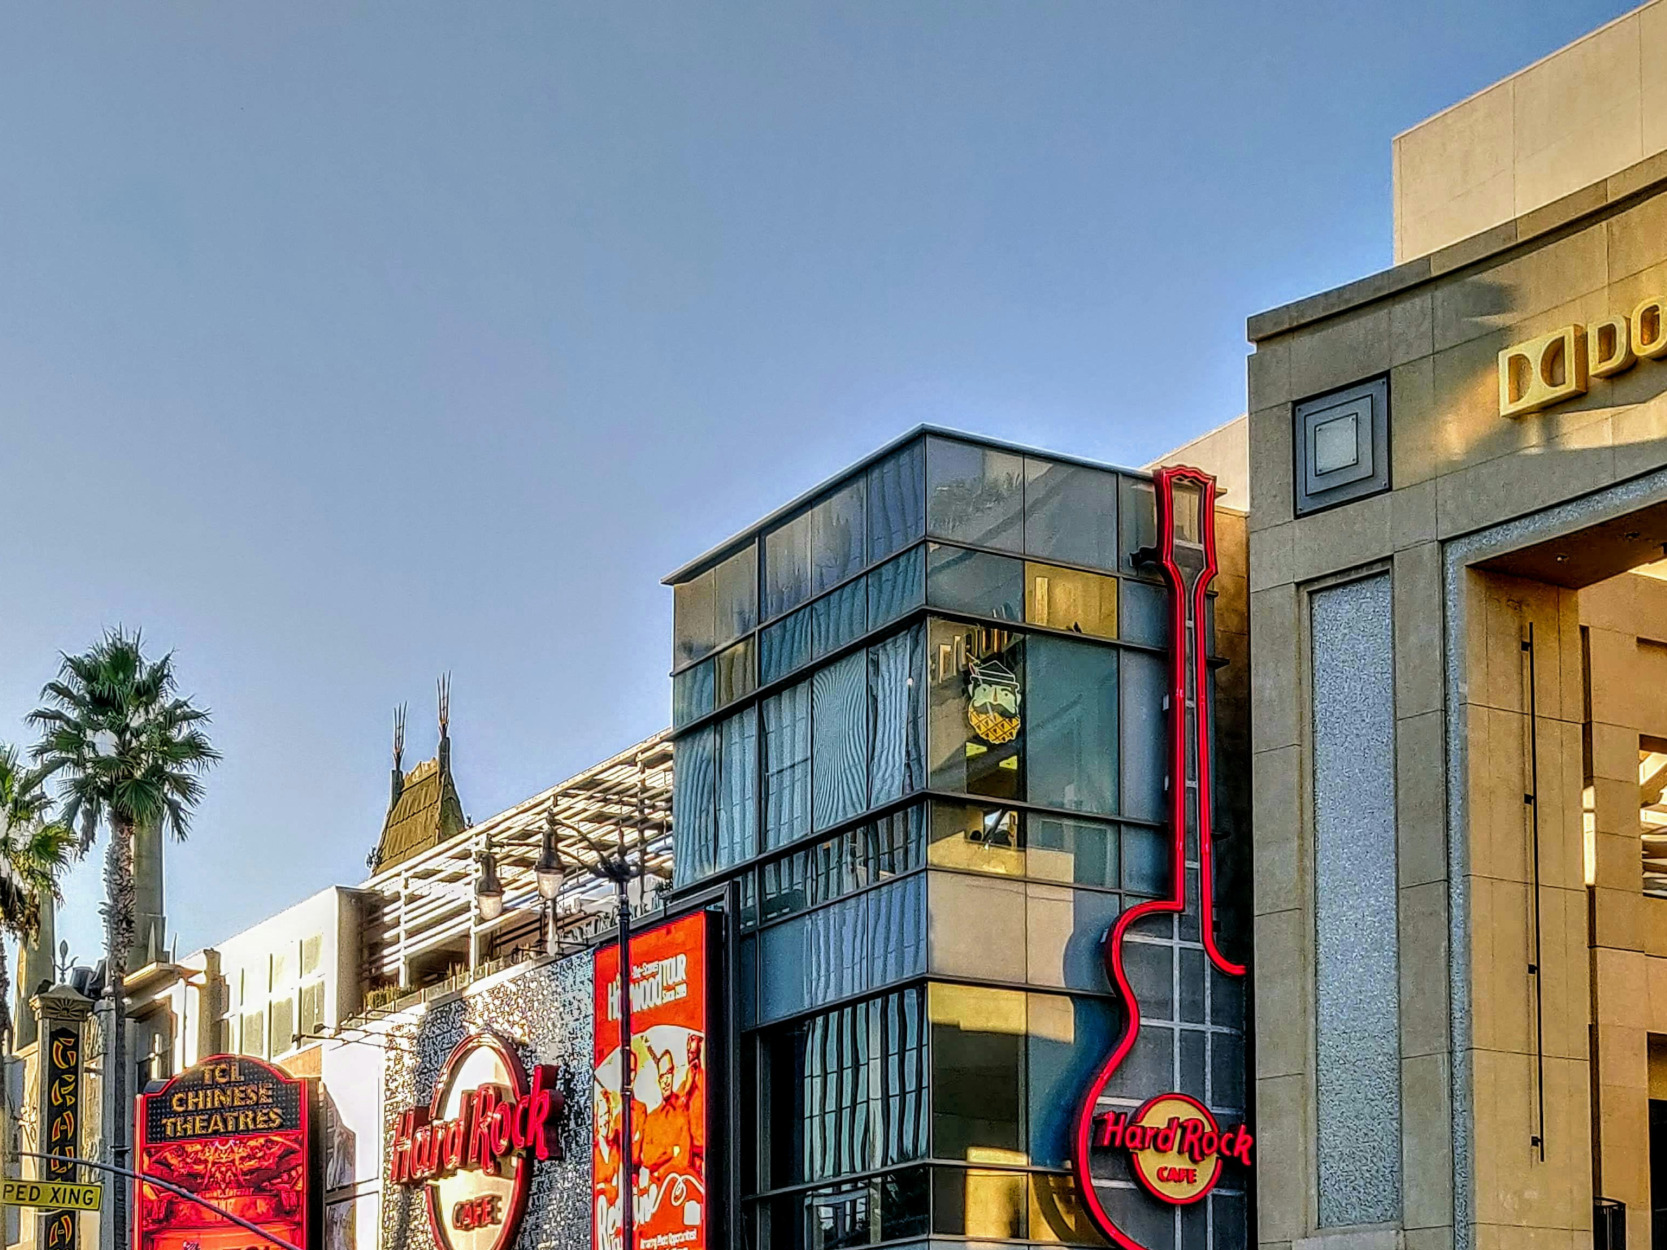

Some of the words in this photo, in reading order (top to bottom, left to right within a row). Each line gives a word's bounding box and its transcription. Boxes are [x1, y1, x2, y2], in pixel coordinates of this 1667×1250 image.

[202, 1061, 245, 1085] TCL
[172, 1083, 275, 1112] CHINESE
[161, 1108, 284, 1138] THEATRES
[389, 1089, 470, 1184] Hard
[470, 1064, 556, 1177] Rock
[1097, 1110, 1181, 1154] Hard
[1180, 1117, 1254, 1166] Rock
[1157, 1166, 1198, 1184] CAFE
[2, 1184, 41, 1201] PED
[49, 1186, 94, 1206] XING
[452, 1197, 500, 1231] CAFE
